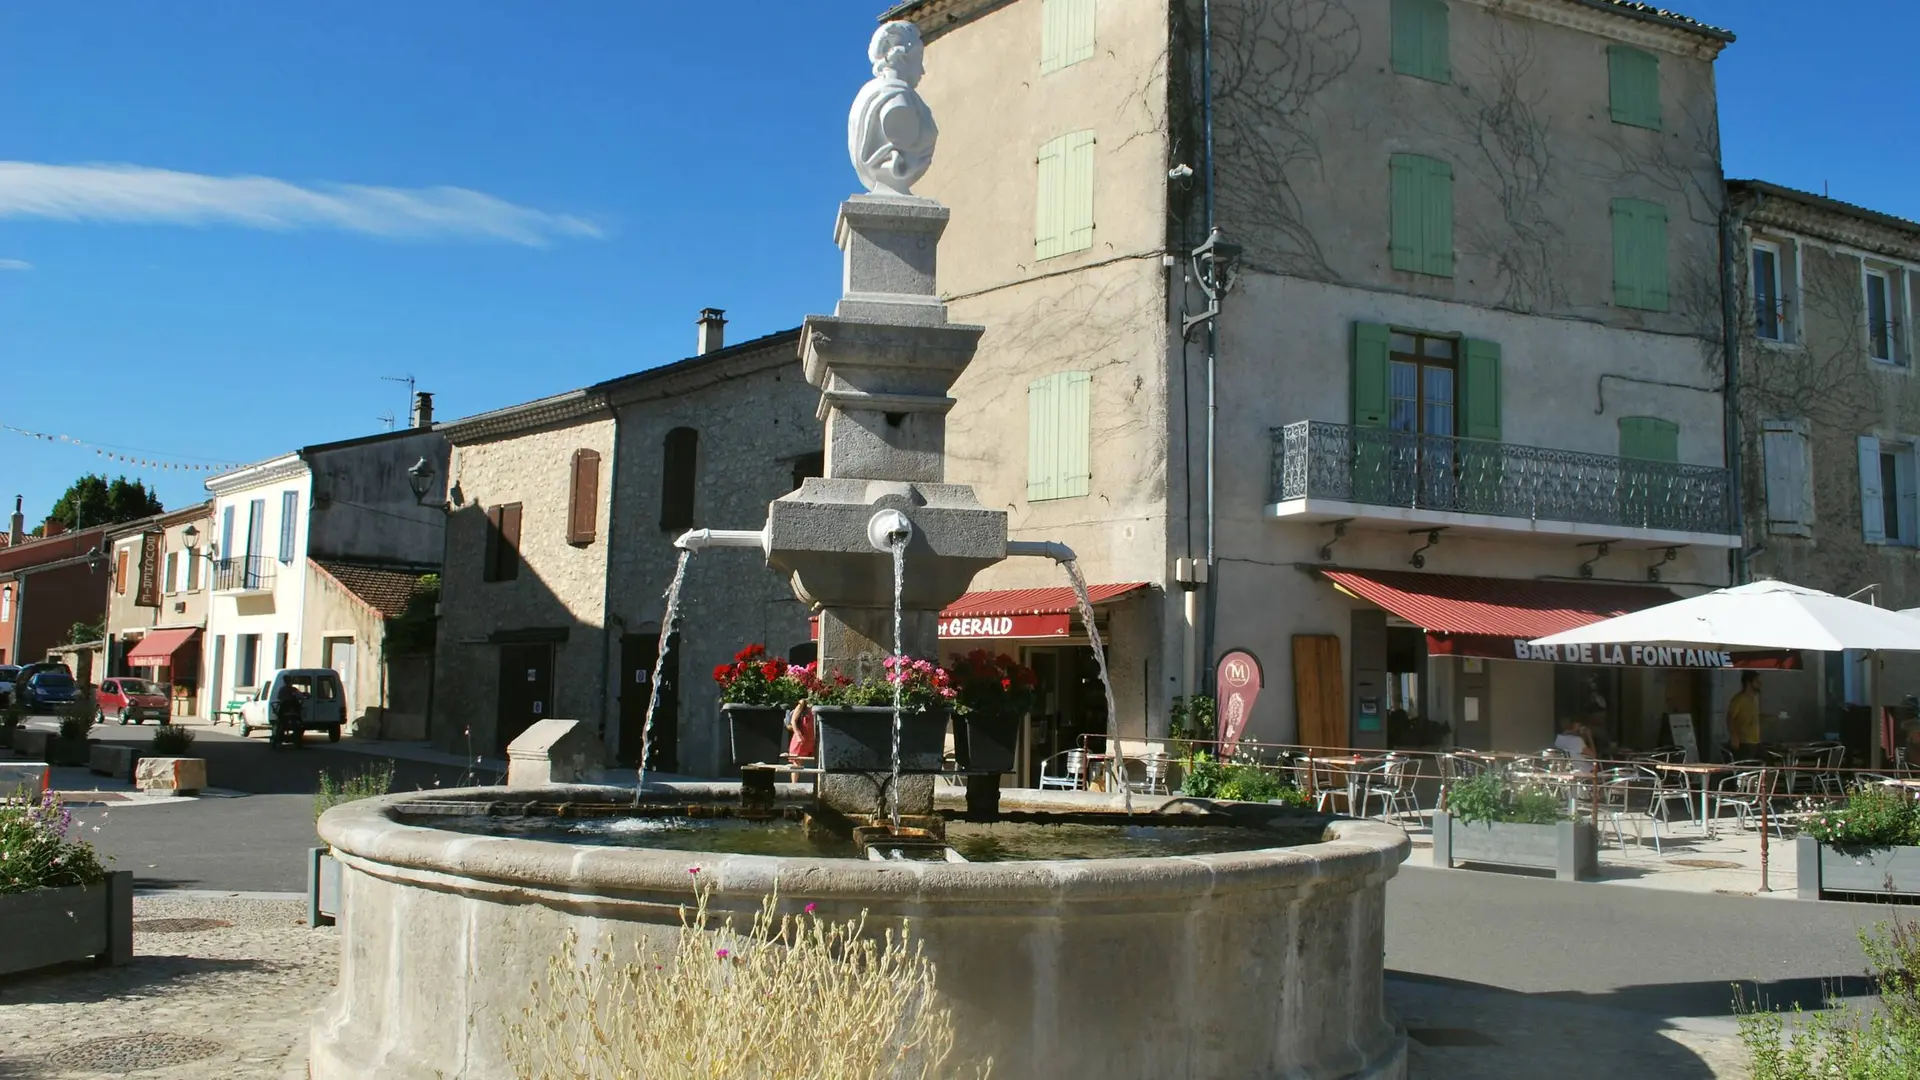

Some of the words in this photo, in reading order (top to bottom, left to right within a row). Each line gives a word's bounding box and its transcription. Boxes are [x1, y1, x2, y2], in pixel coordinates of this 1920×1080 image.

[142, 536, 156, 603] BOUCHERIE
[950, 617, 1012, 636] GERALD
[1513, 639, 1559, 661] BAR
[1564, 643, 1593, 663] DE
[1599, 644, 1626, 664] LA
[1631, 645, 1734, 668] FONTAINE
[1230, 664, 1245, 678] M
